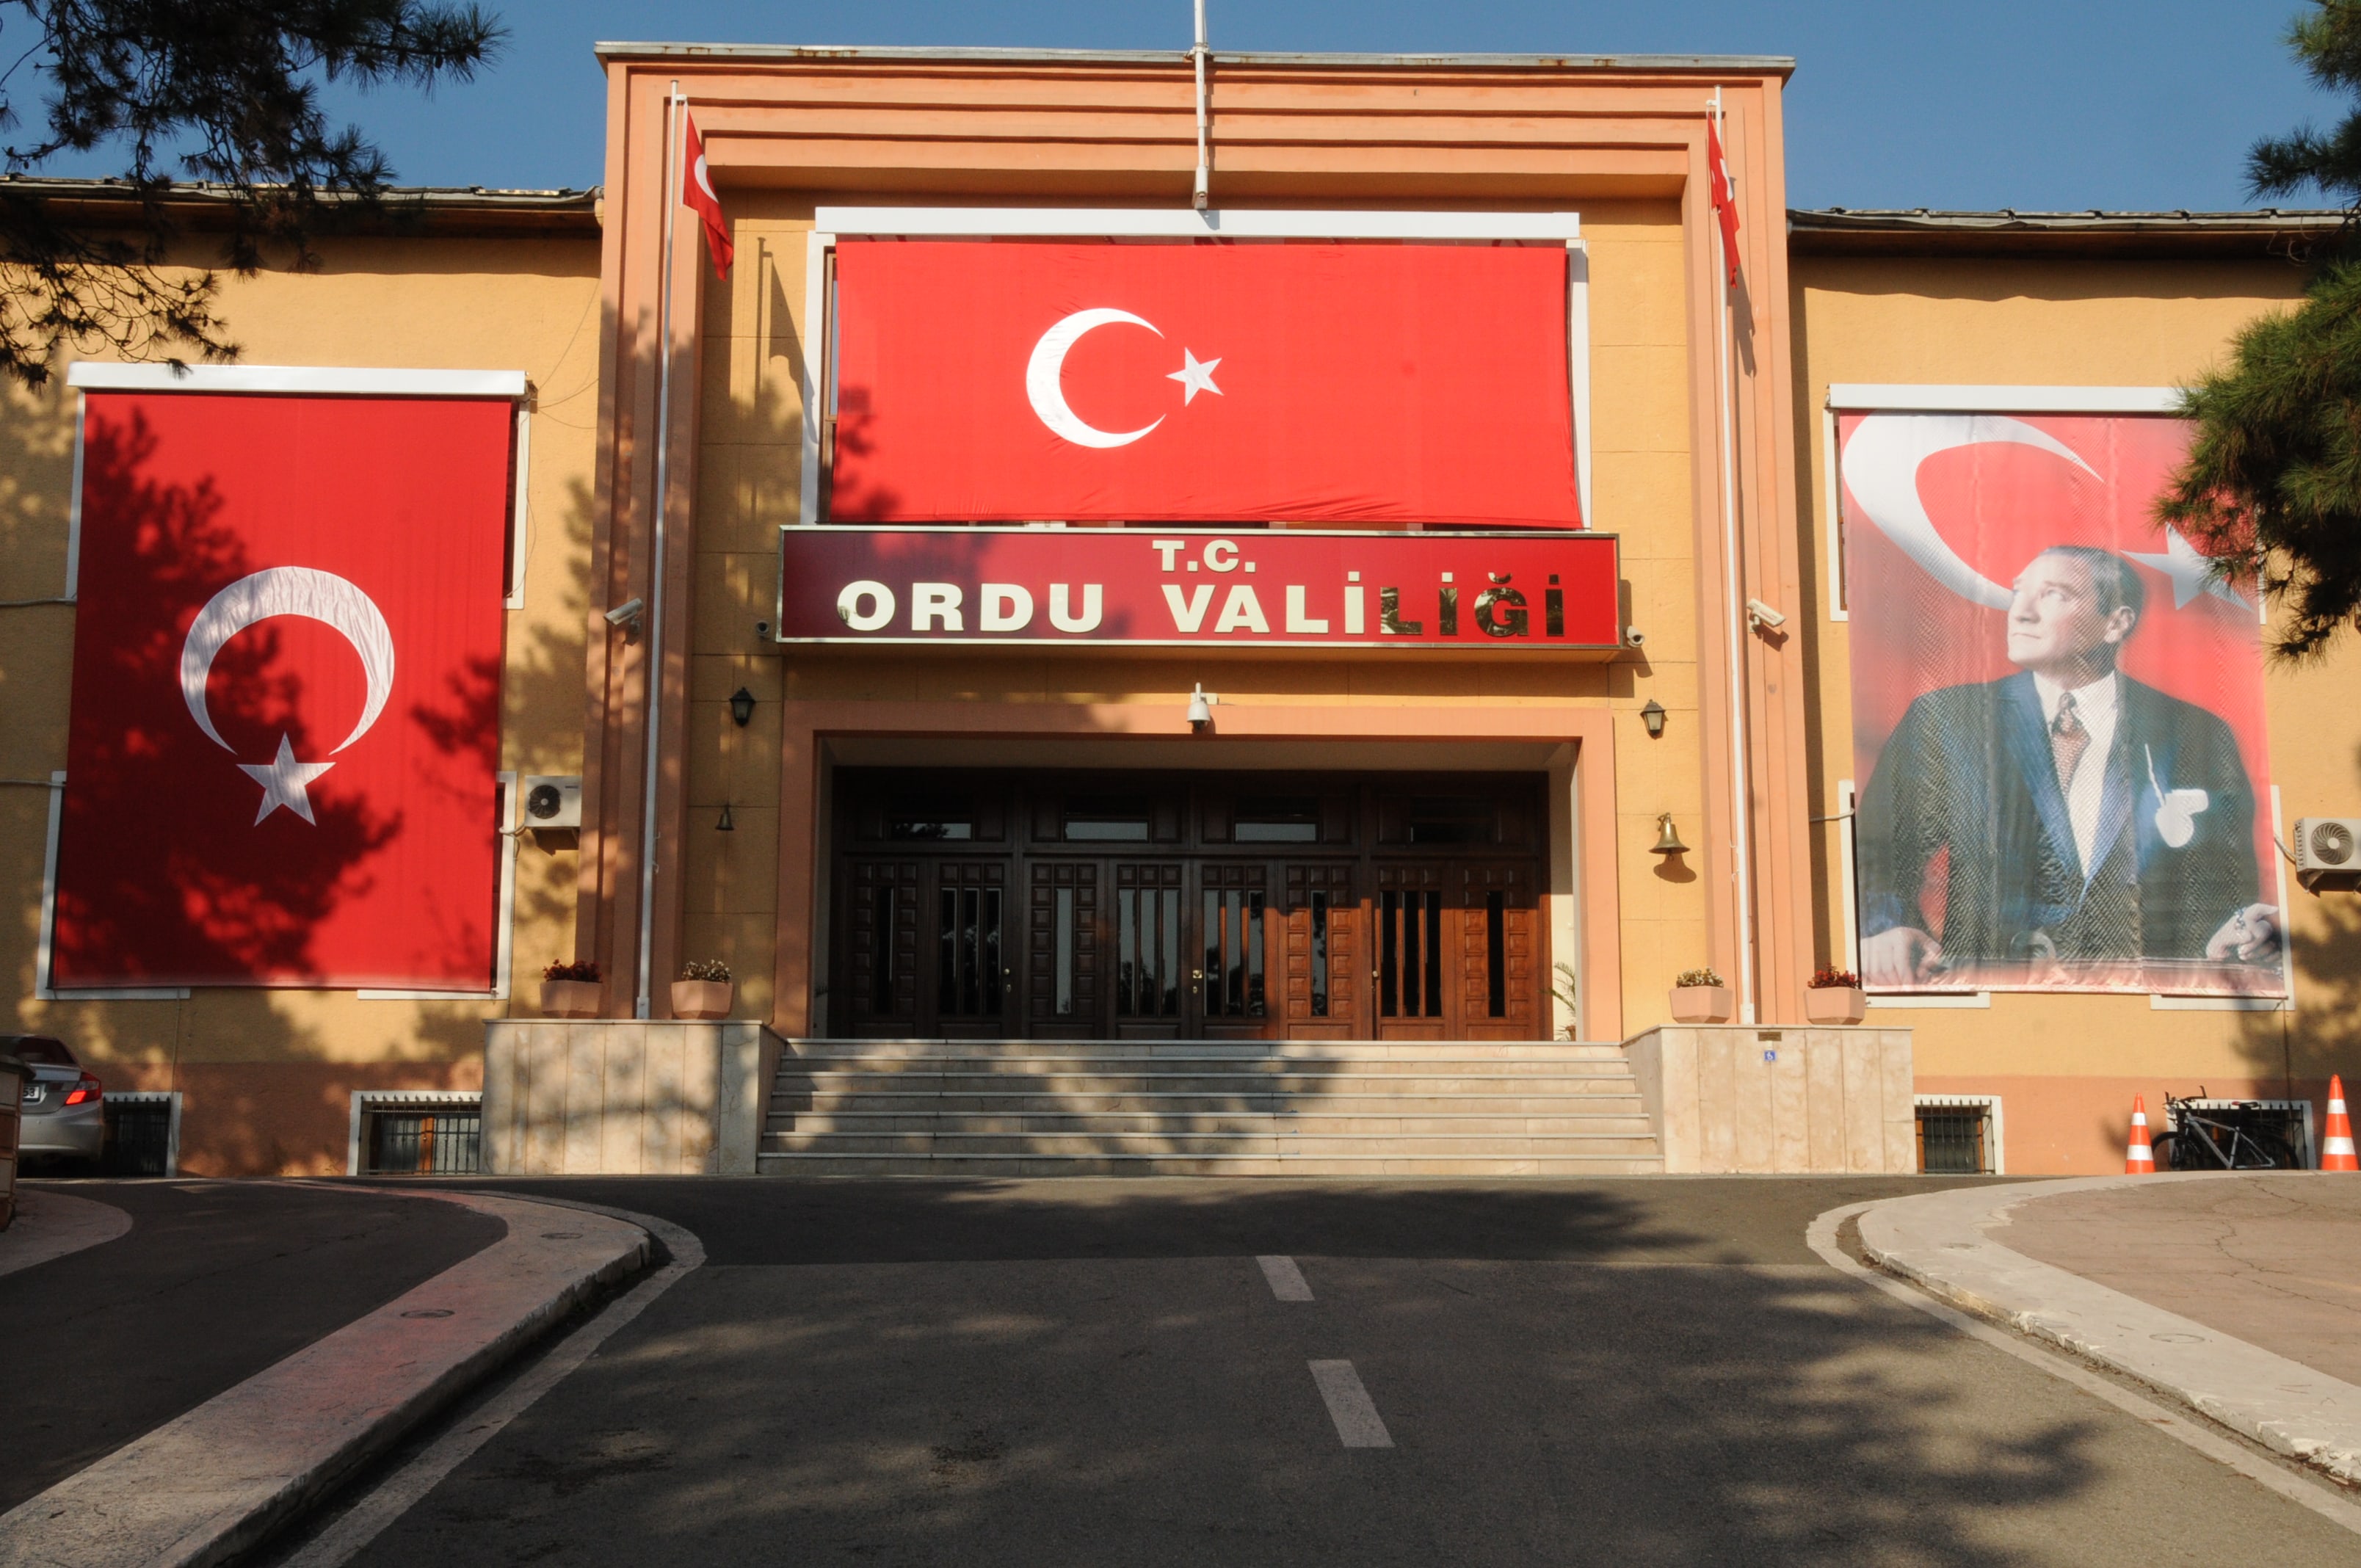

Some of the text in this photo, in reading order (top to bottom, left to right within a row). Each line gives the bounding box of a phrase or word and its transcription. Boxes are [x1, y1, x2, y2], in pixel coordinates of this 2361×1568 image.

[1152, 540, 1255, 573] T.C.
[836, 571, 1564, 636] ORDU VALİLİĞİ
